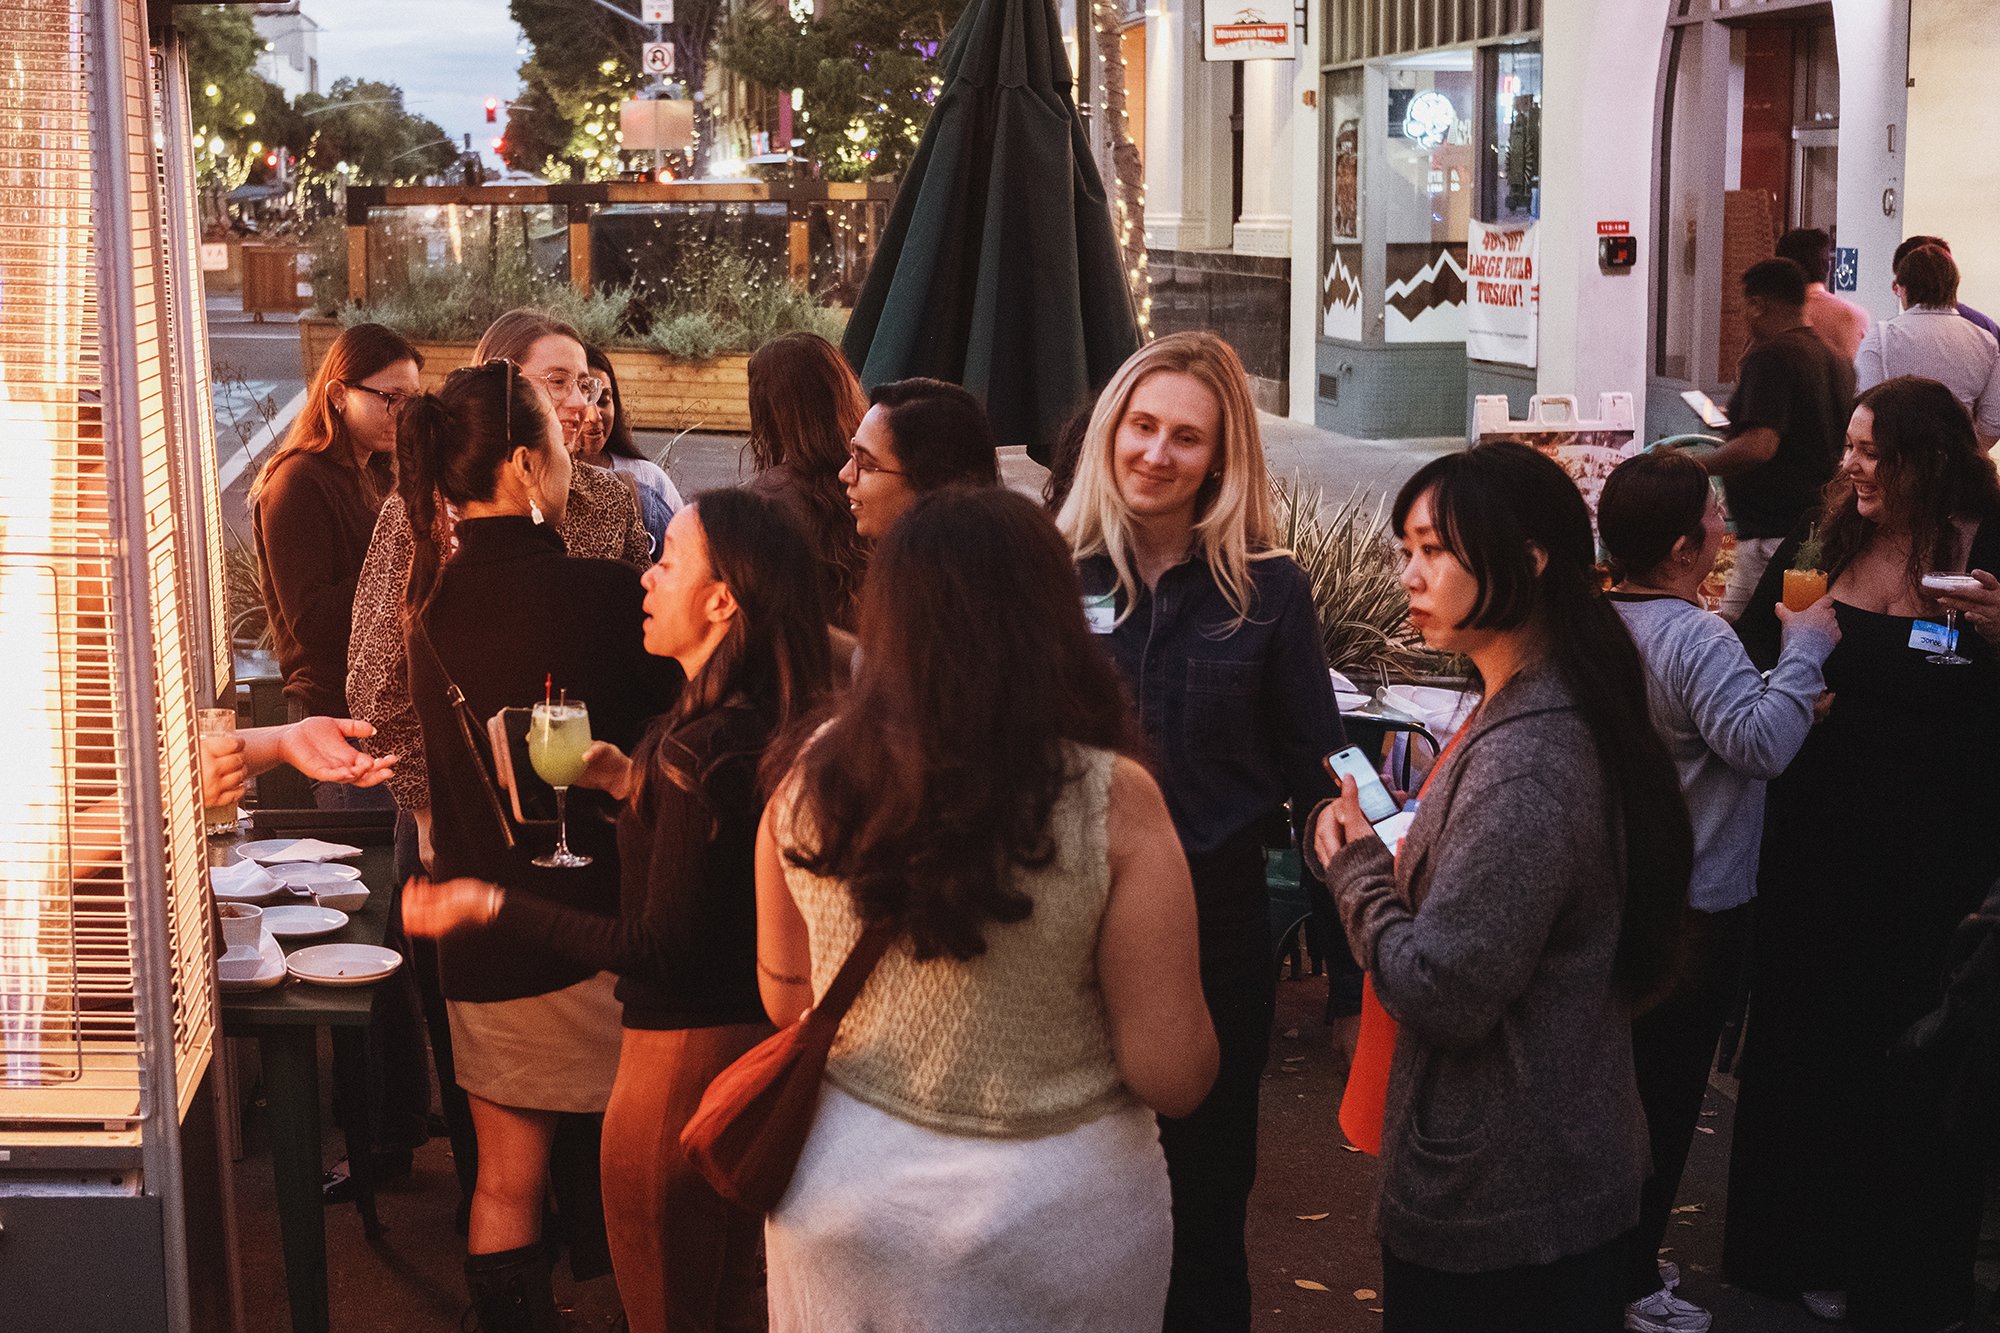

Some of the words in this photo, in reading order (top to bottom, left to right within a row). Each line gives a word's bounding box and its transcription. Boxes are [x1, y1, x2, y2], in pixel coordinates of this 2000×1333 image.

[1503, 230, 1525, 252] OFF
[1469, 254, 1502, 277] LARGE
[1504, 256, 1532, 279] PIZZA
[1477, 281, 1523, 307] TUESDAY!
